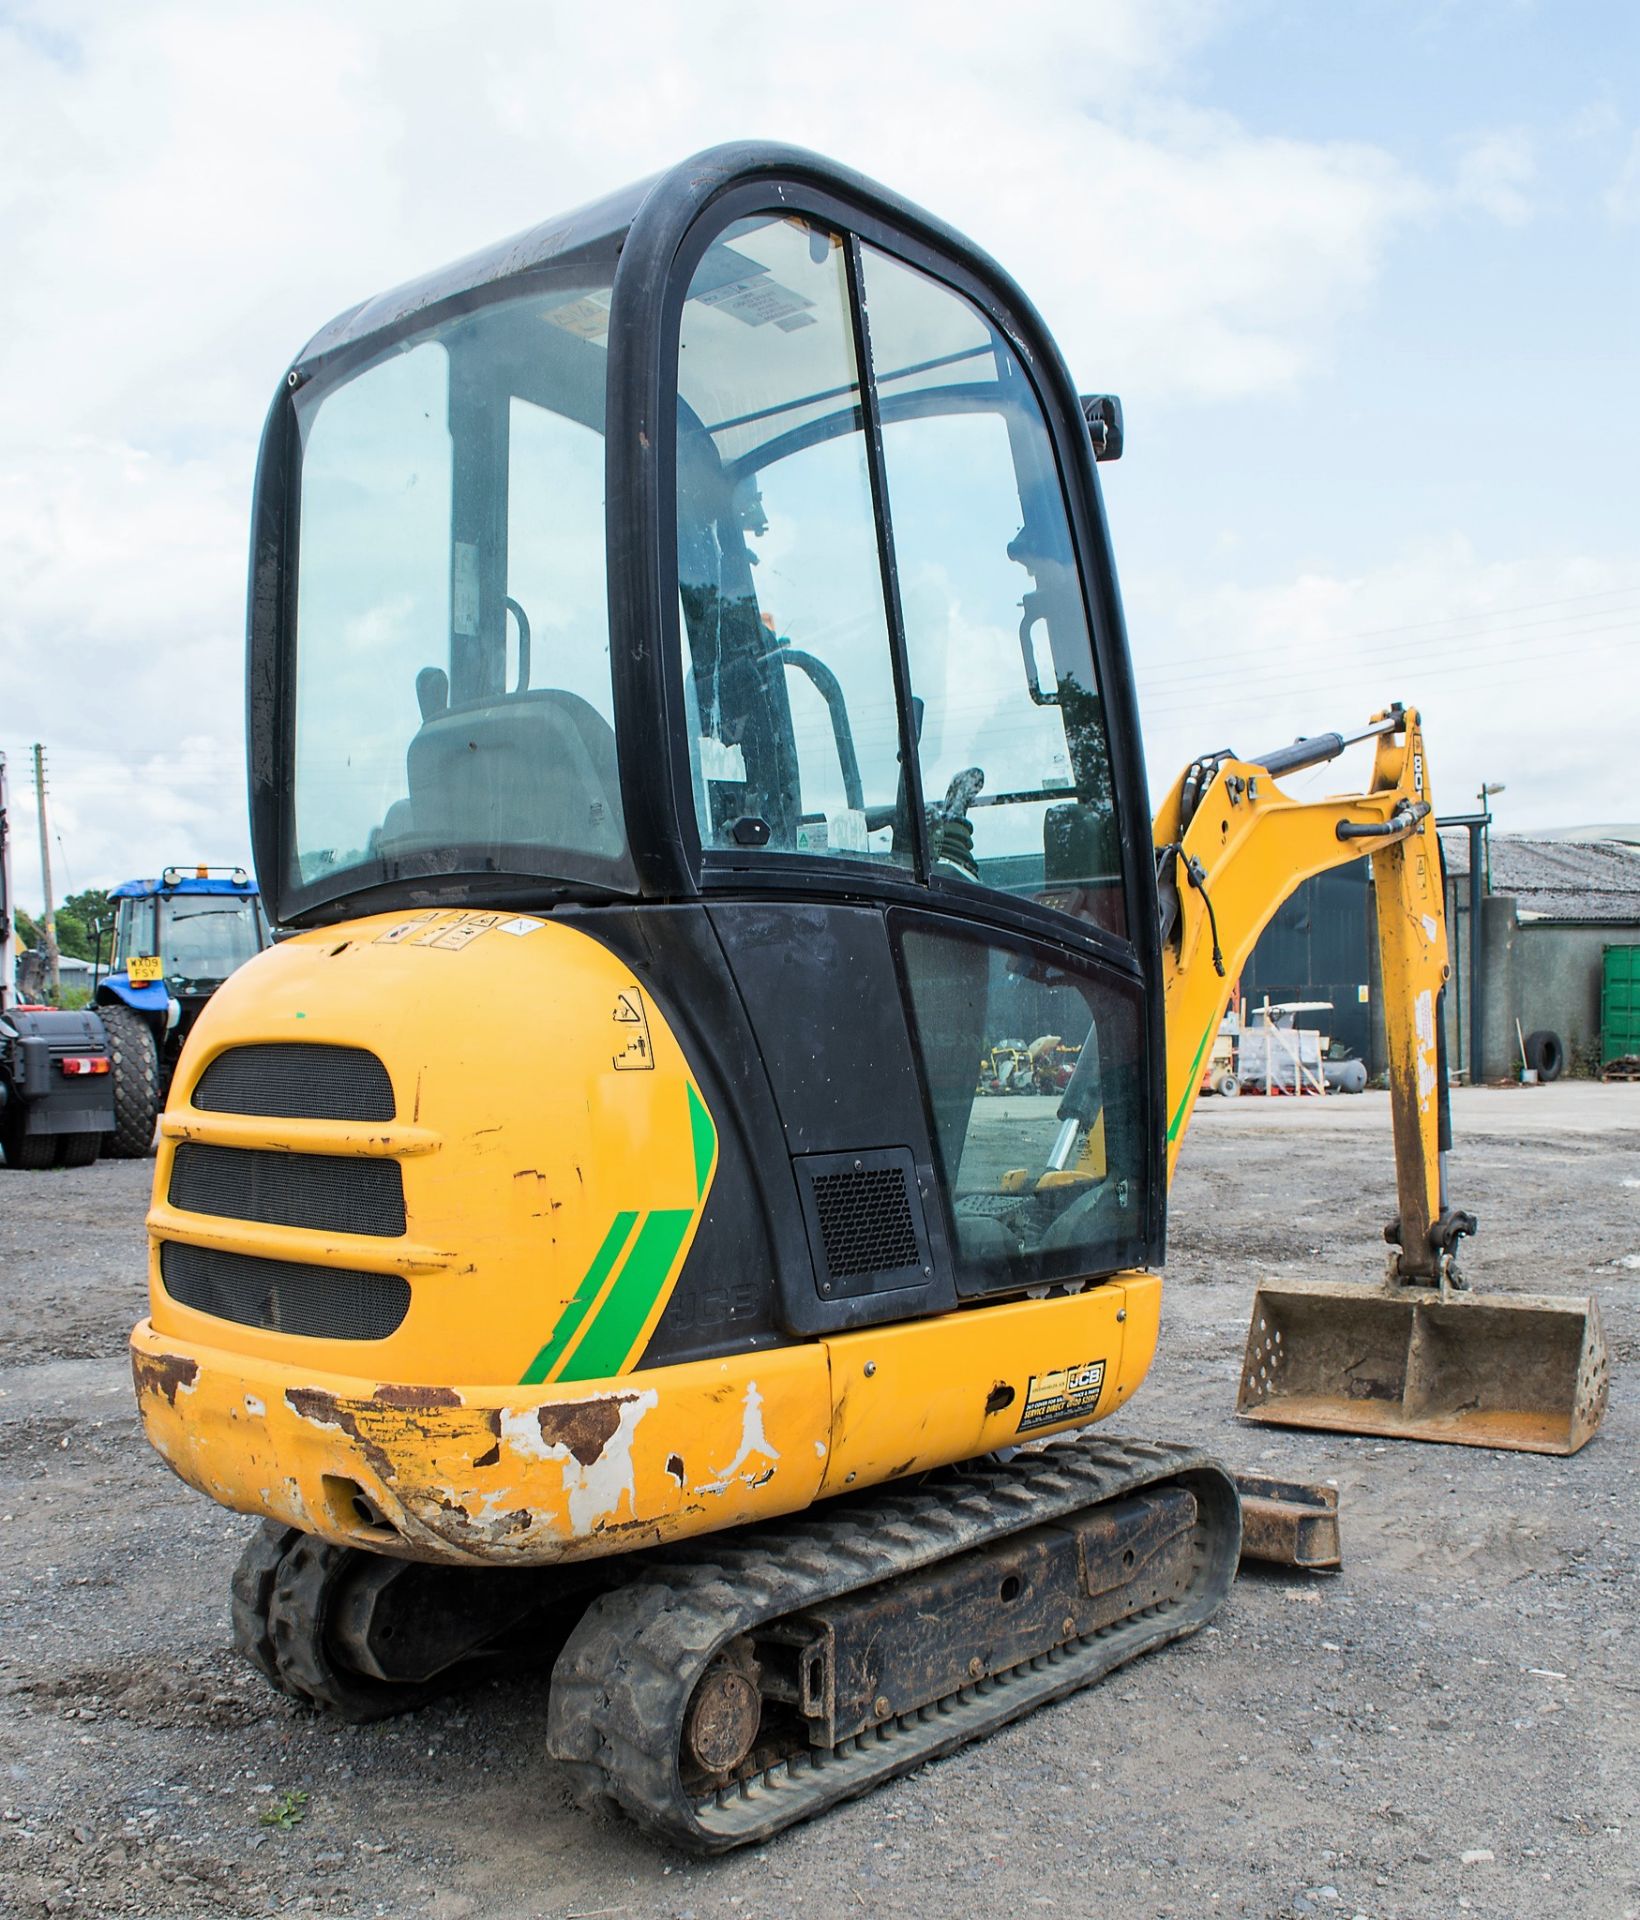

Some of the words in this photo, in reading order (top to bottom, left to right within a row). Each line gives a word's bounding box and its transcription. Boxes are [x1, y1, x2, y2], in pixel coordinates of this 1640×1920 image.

[131, 958, 158, 968] WX09
[135, 968, 155, 978] FSY
[1069, 1368, 1100, 1388] JCB
[1024, 1407, 1046, 1419] SERVICE
[1046, 1402, 1066, 1413] DIRECT
